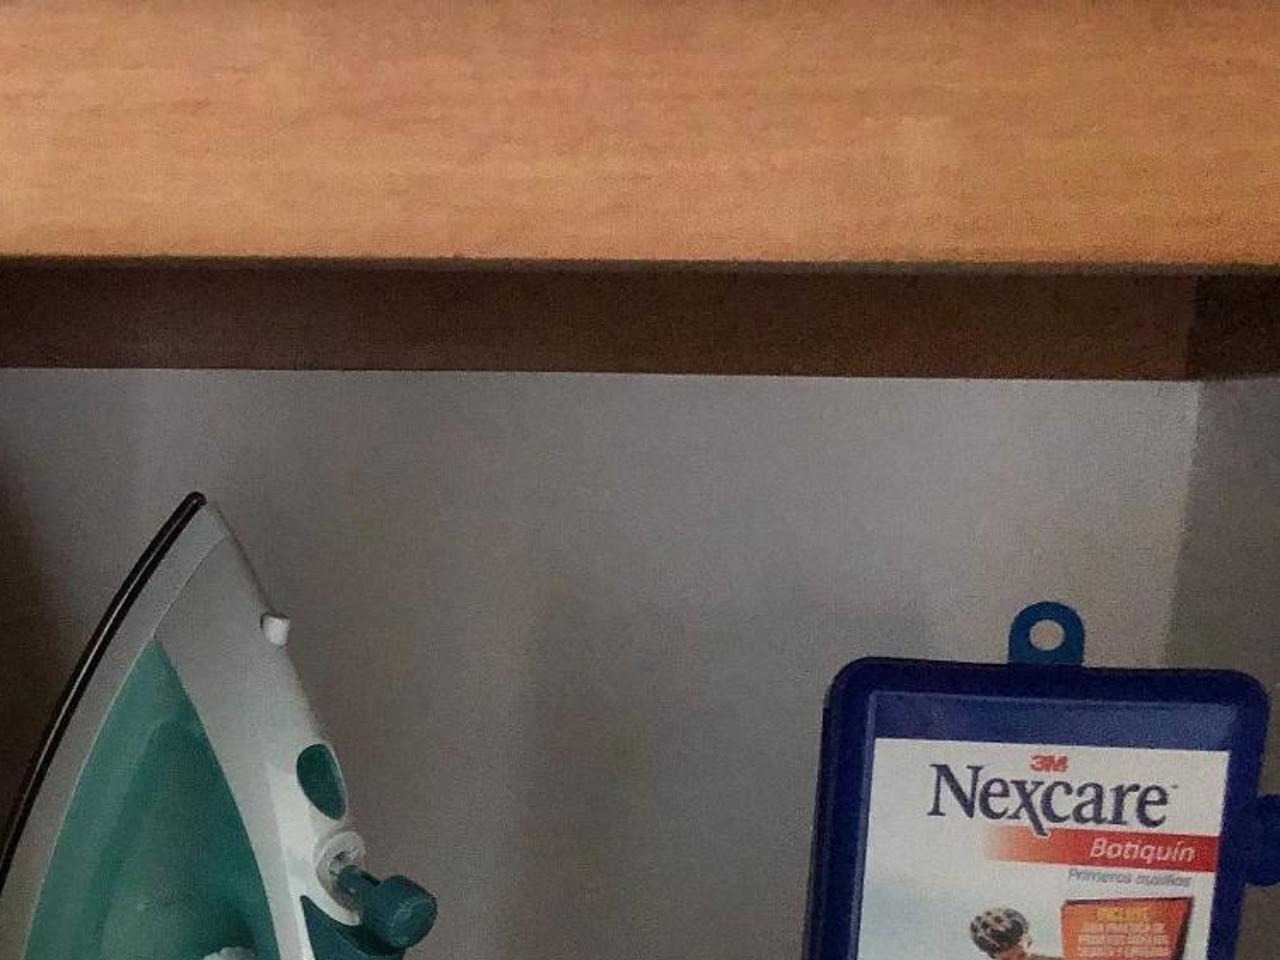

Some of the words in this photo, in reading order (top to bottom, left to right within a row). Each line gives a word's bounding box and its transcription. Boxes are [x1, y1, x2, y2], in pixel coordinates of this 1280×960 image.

[1030, 754, 1069, 773] 3M
[927, 763, 1170, 837] Nexcare
[1089, 837, 1197, 865] Botiquín
